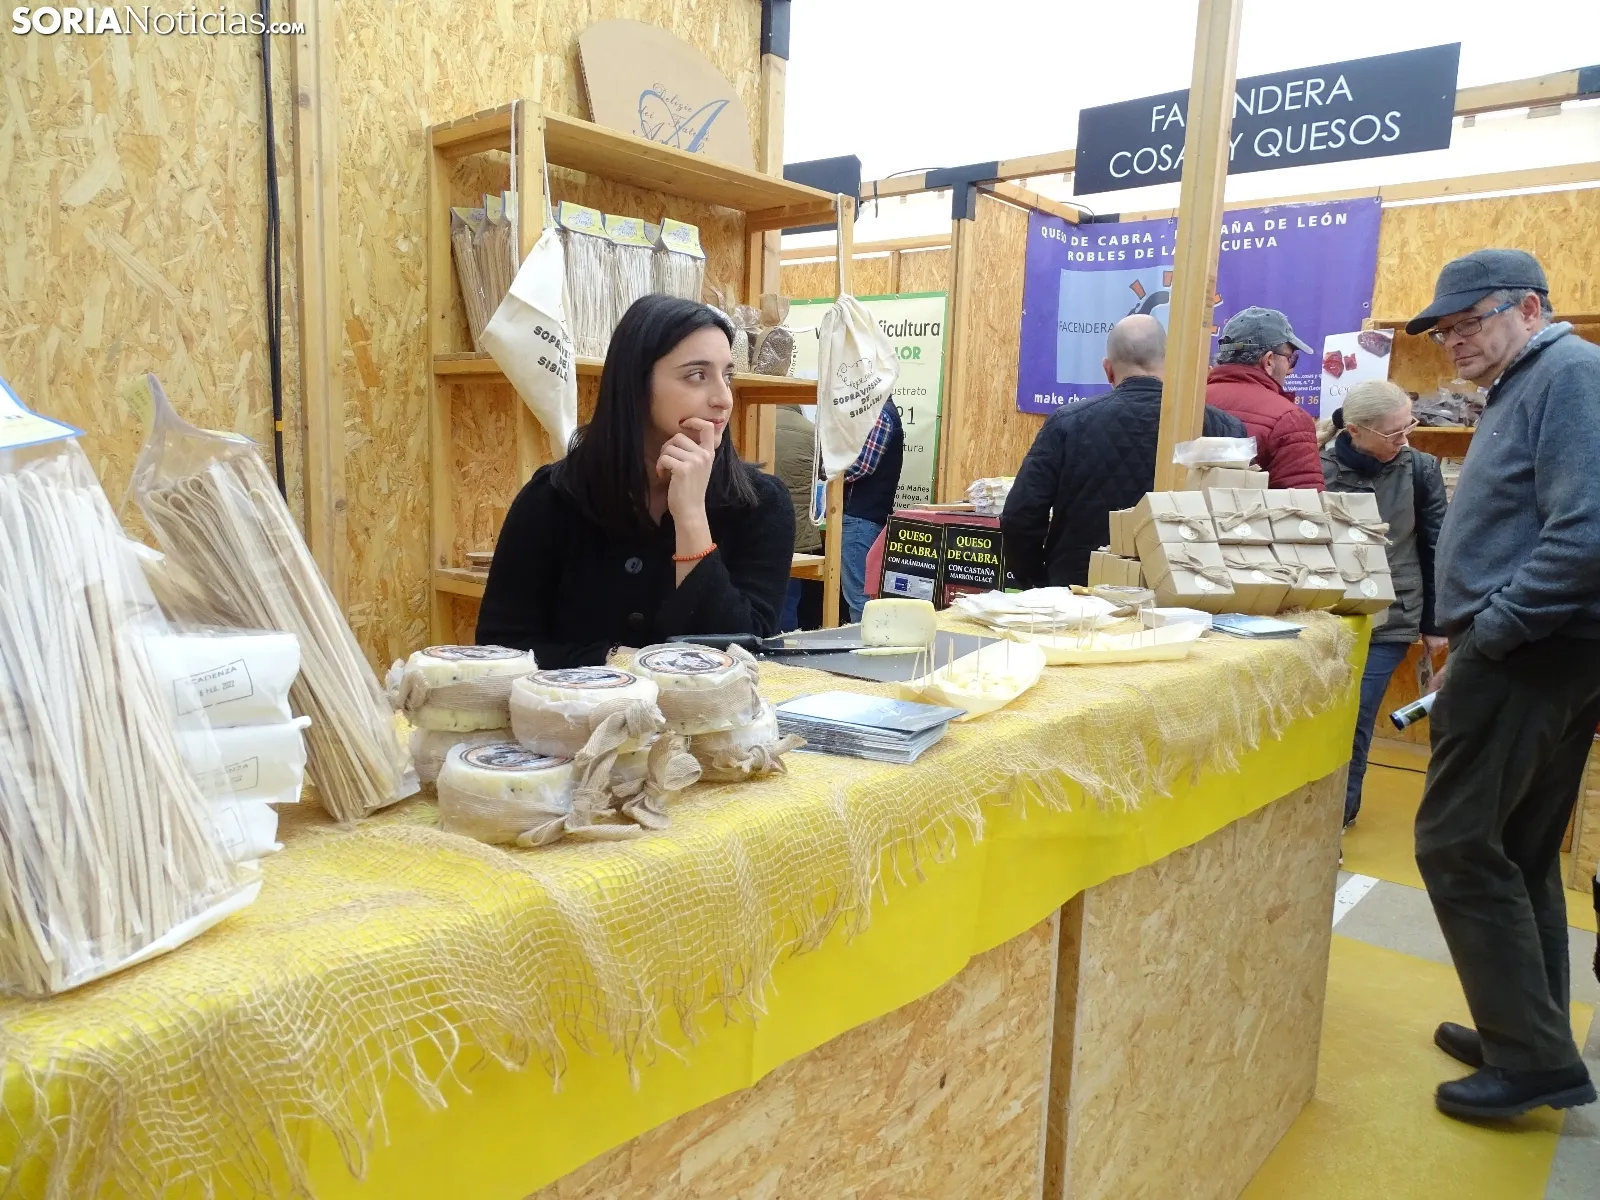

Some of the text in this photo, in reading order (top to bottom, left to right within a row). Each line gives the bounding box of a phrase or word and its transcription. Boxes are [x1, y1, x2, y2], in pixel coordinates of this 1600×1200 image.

[1151, 74, 1353, 133] FANDERA
[1229, 132, 1244, 161] Y
[1253, 110, 1401, 158] QUESOS
[1041, 226, 1067, 243] QUESO
[1071, 236, 1089, 246] DE
[1098, 232, 1153, 246] CABRA
[1264, 217, 1287, 231] DE
[1297, 211, 1348, 228] LEÓN
[1067, 250, 1126, 262] ROBLES
[1134, 247, 1154, 259] DE
[1059, 320, 1115, 334] FACENDERA
[1034, 392, 1064, 404] make
[907, 484, 930, 492] Mañes
[898, 529, 932, 543] QUESO
[956, 535, 992, 549] QUESO
[889, 541, 938, 559] DE CABRA
[947, 549, 999, 565] DE CABRA
[948, 564, 963, 573] CON
[964, 566, 996, 577] CASTAÑA
